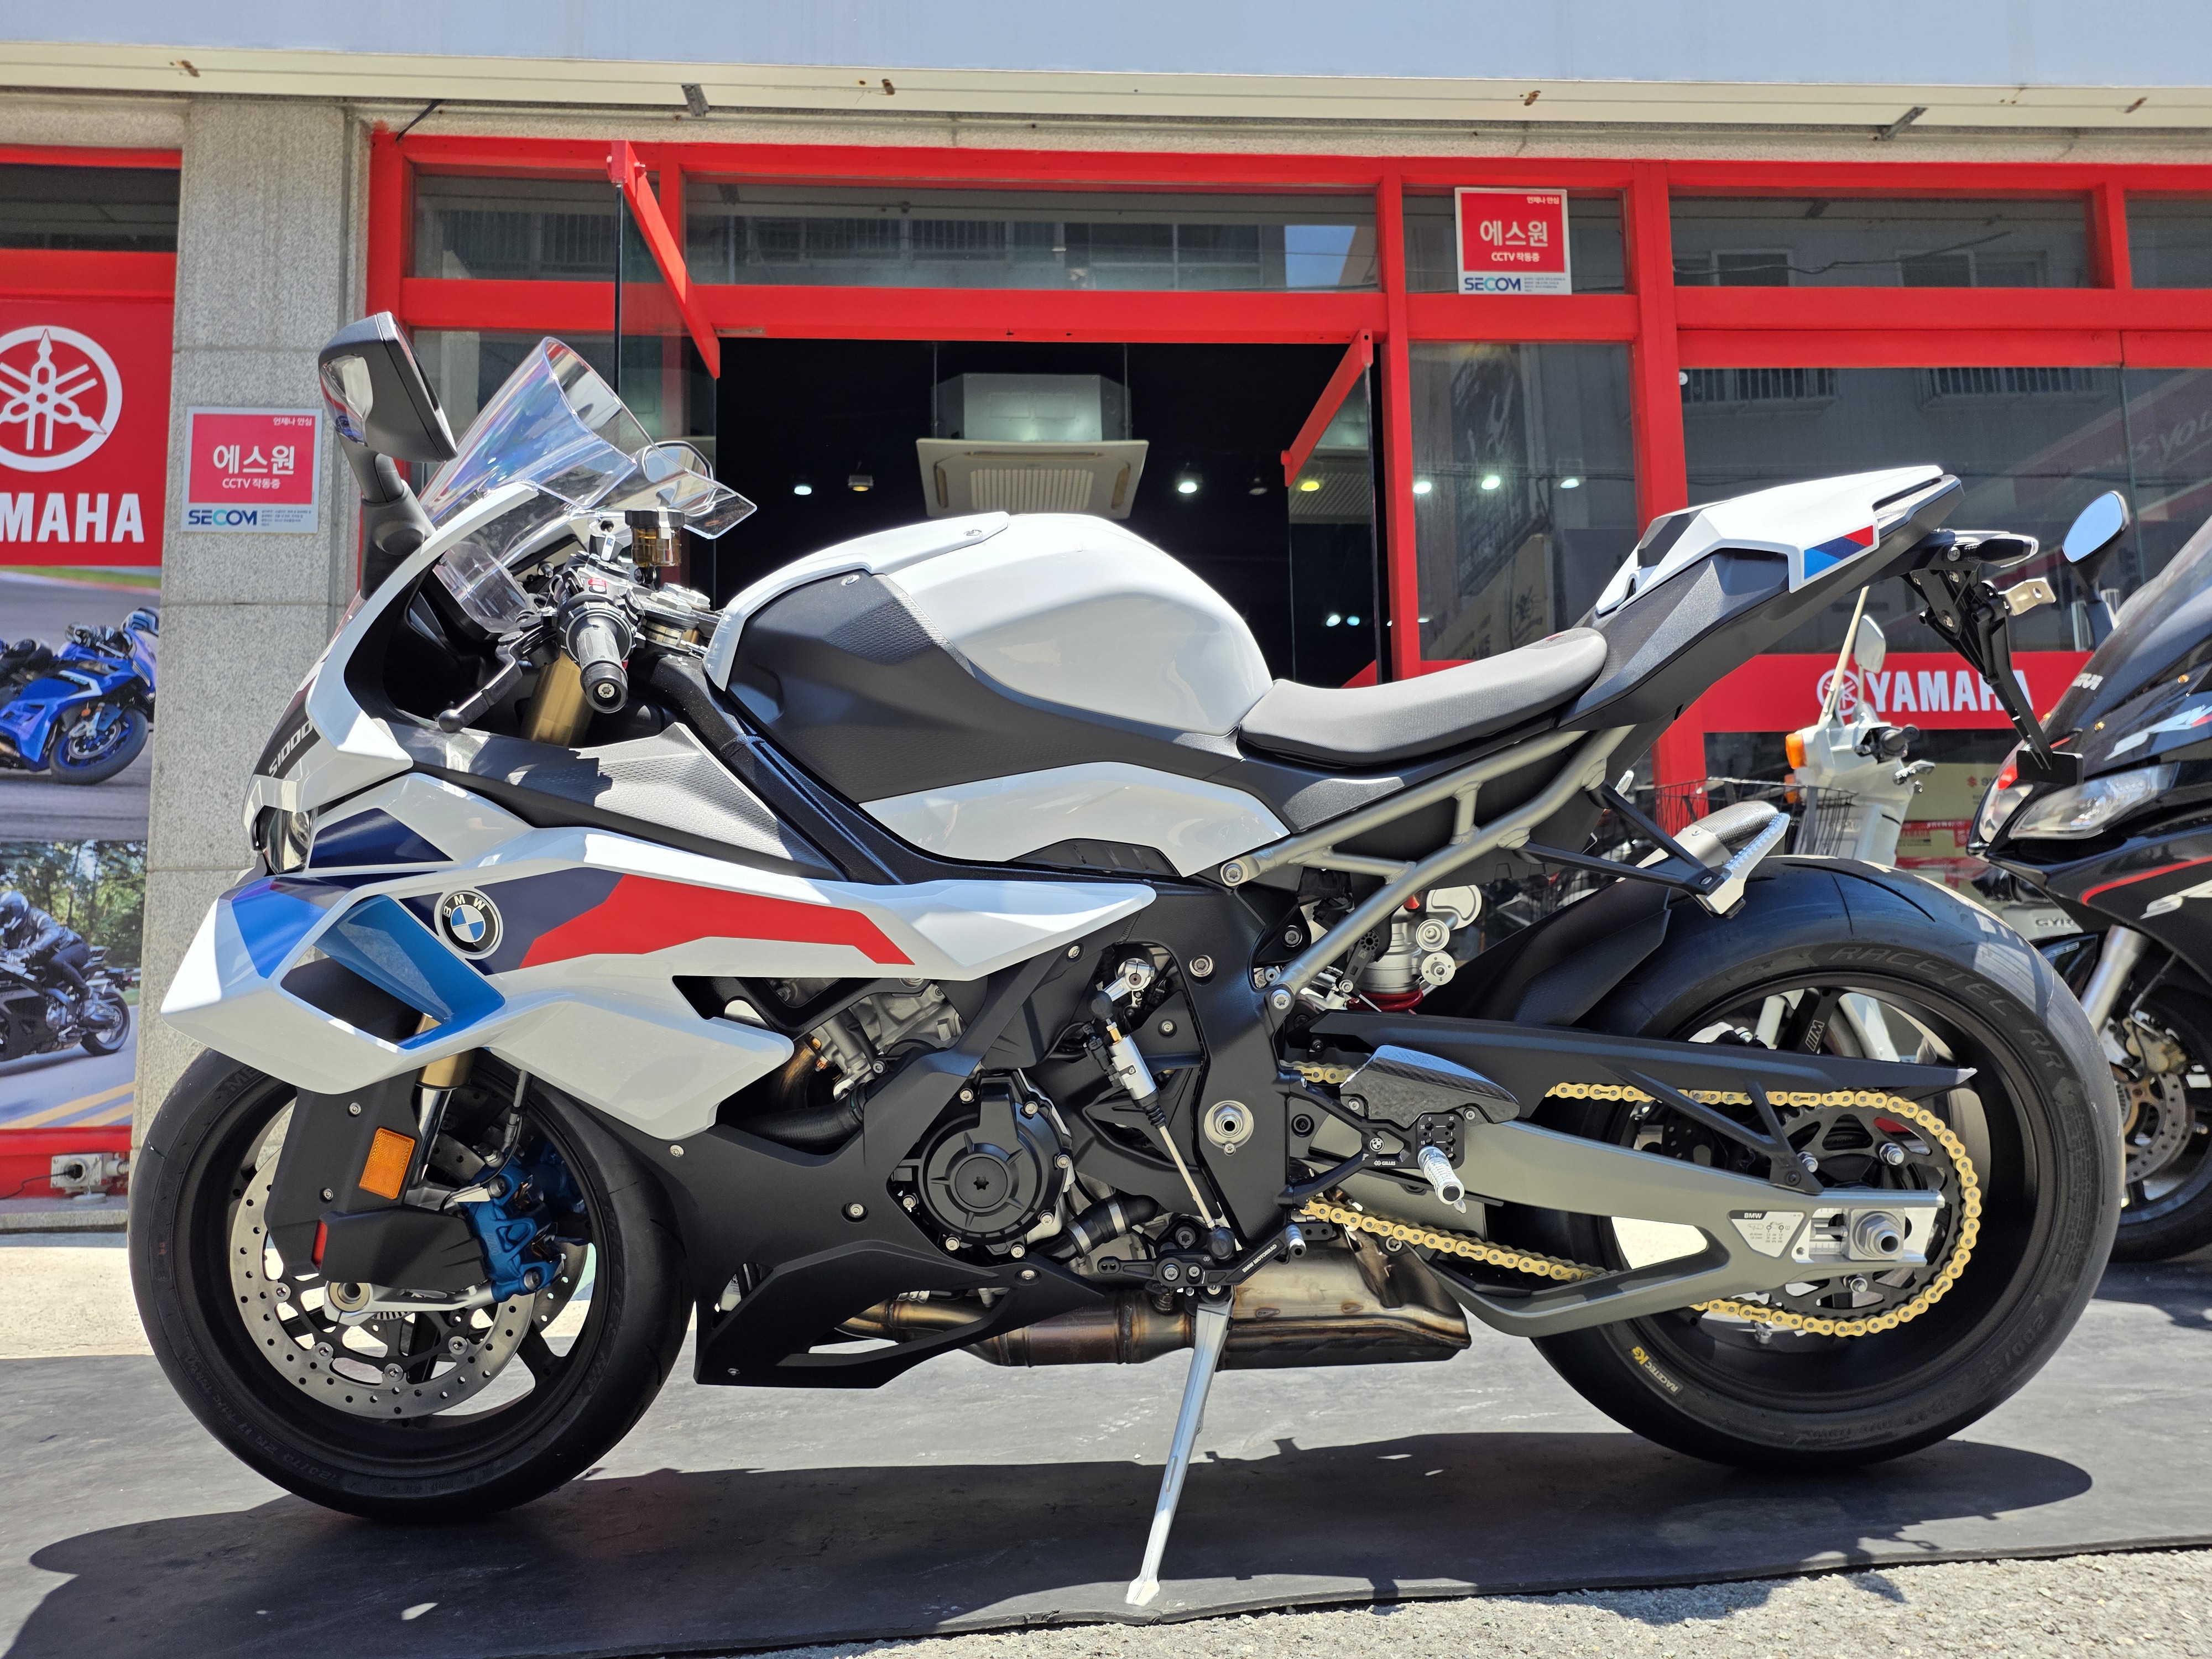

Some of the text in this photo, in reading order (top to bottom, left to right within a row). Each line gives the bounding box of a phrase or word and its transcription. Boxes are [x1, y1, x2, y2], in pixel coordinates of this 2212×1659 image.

[1480, 220, 1548, 247] 에스원
[1491, 252, 1540, 262] CCTV 작동중
[1464, 277, 1521, 291] SECOM
[273, 417, 312, 426] 언제나 안심
[213, 445, 295, 475] 에스원
[222, 478, 281, 489] CCTV 작동중
[0, 492, 144, 543] MAHA
[188, 509, 258, 526] SECOM
[269, 719, 313, 778] S1000
[443, 894, 486, 918] BMW
[2036, 918, 2075, 927] GYR
[1829, 946, 2067, 1070] RACETEC RR
[1632, 1346, 1650, 1365] K3
